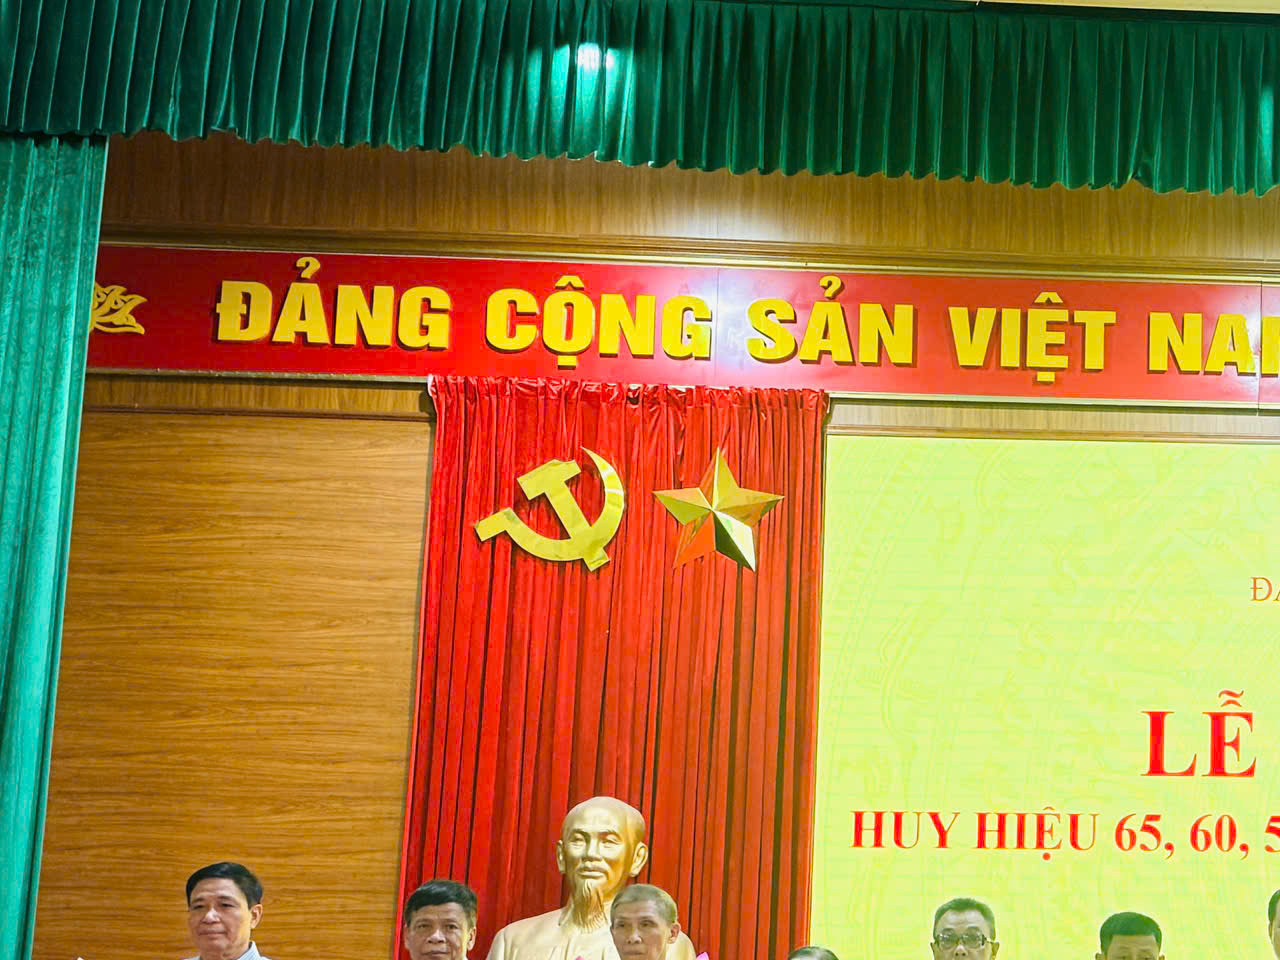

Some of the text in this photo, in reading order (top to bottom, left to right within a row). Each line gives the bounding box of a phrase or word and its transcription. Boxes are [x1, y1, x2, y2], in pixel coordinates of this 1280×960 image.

[216, 256, 451, 350] ĐẢNG
[485, 275, 713, 369] CỘNG
[745, 275, 917, 366] SẢN
[947, 291, 1117, 383] VIỆT
[1140, 689, 1258, 778] LỄ
[850, 810, 960, 849] HUY
[975, 806, 1100, 860] HIỆU
[1114, 813, 1175, 860] 65,
[1189, 814, 1250, 861] 60,
